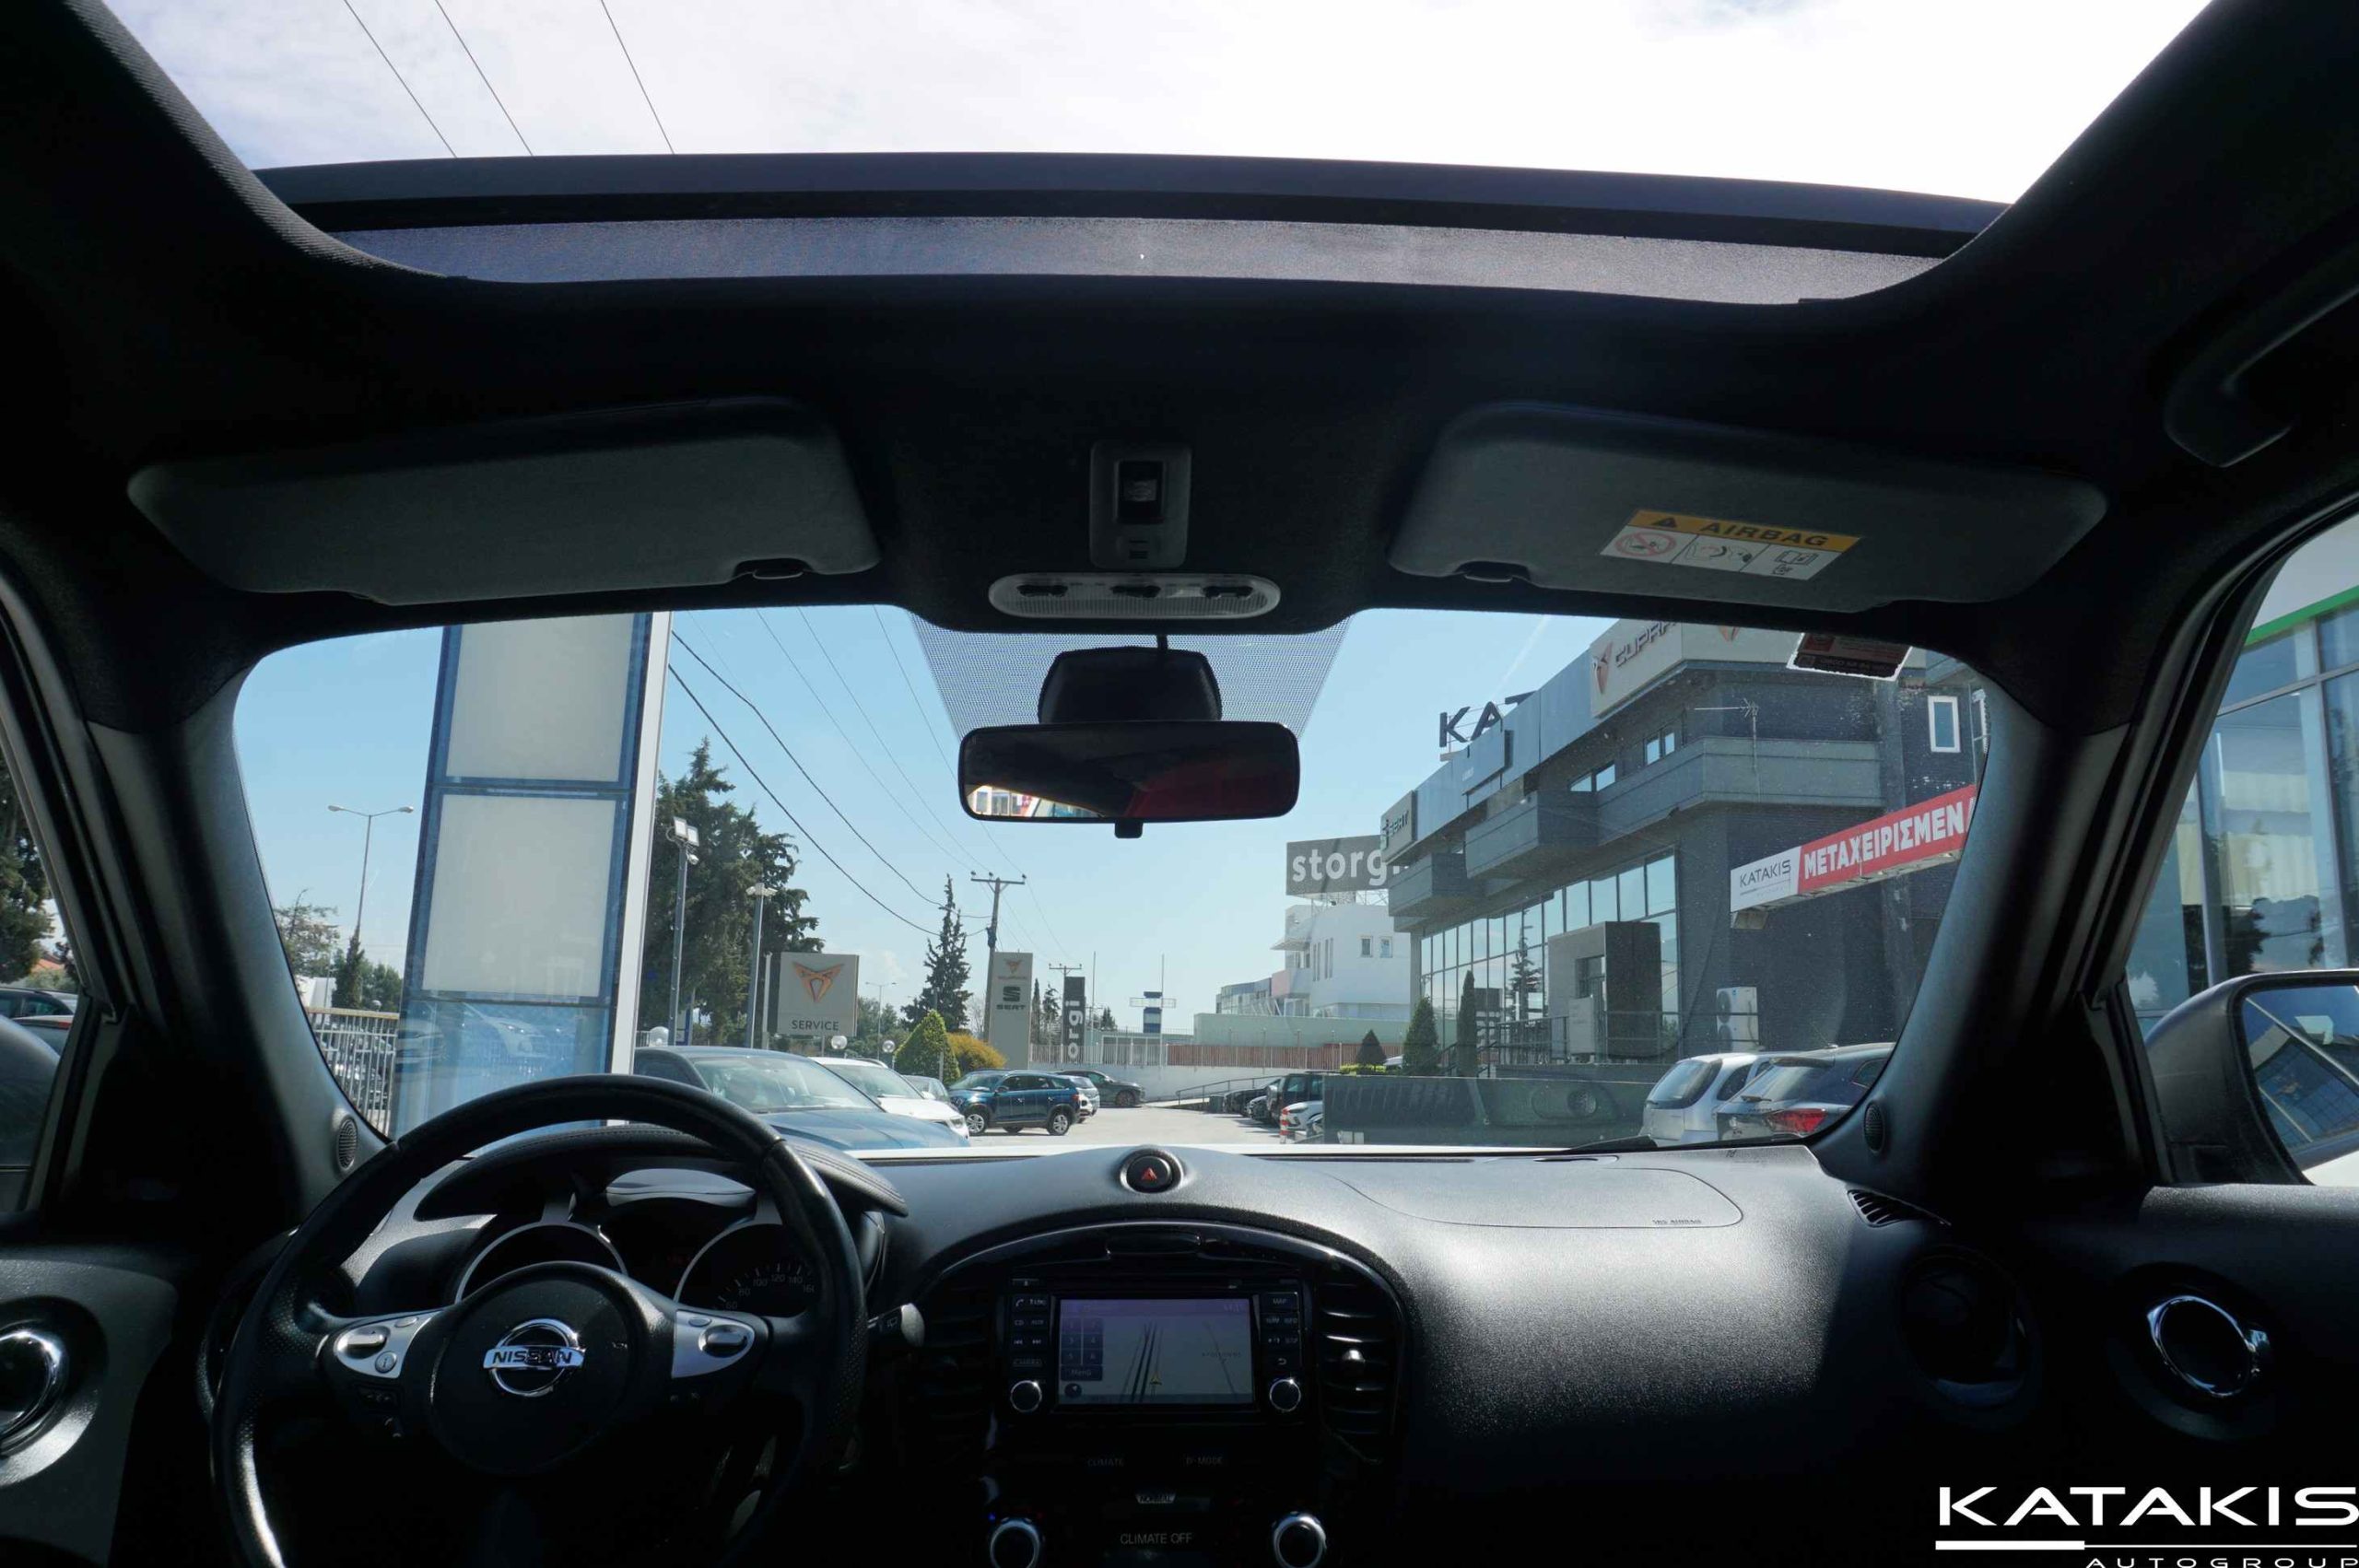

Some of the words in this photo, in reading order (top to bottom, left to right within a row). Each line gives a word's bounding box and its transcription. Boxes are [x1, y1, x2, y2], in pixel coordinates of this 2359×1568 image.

[1699, 521, 1830, 547] AIRBAG
[1739, 858, 1792, 888] KATAKIS
[791, 1019, 839, 1031] SERVICE
[753, 1278, 769, 1287] 100
[770, 1273, 786, 1282] 120
[492, 1349, 573, 1366] NISSAN
[1086, 1457, 1124, 1467] CLIMATE
[1120, 1532, 1168, 1545] CLIMATE
[1169, 1532, 1193, 1545] OFF
